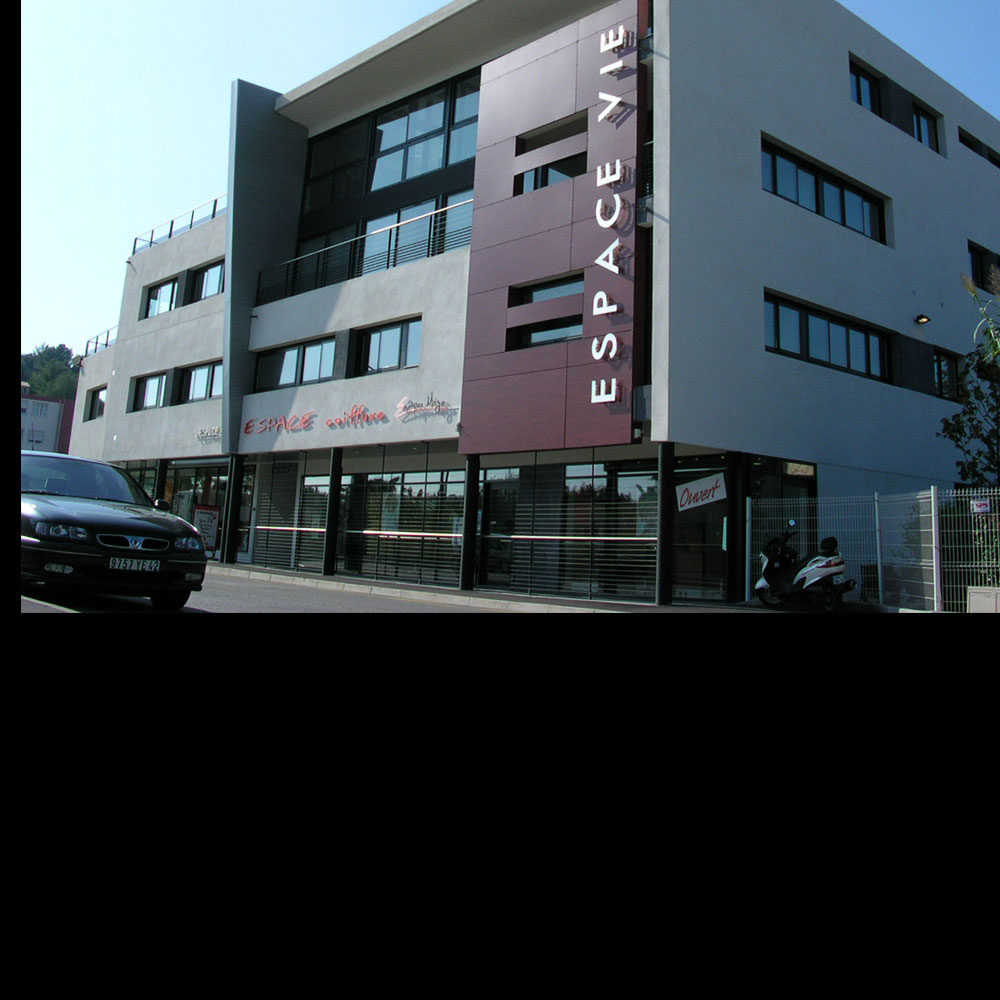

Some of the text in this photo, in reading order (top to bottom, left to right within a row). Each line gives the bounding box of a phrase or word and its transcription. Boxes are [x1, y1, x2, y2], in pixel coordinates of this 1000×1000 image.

[591, 24, 625, 404] ESPACE VIE
[243, 410, 315, 434] ESPACE
[325, 403, 387, 427] coiffure
[680, 478, 721, 508] Ouvert
